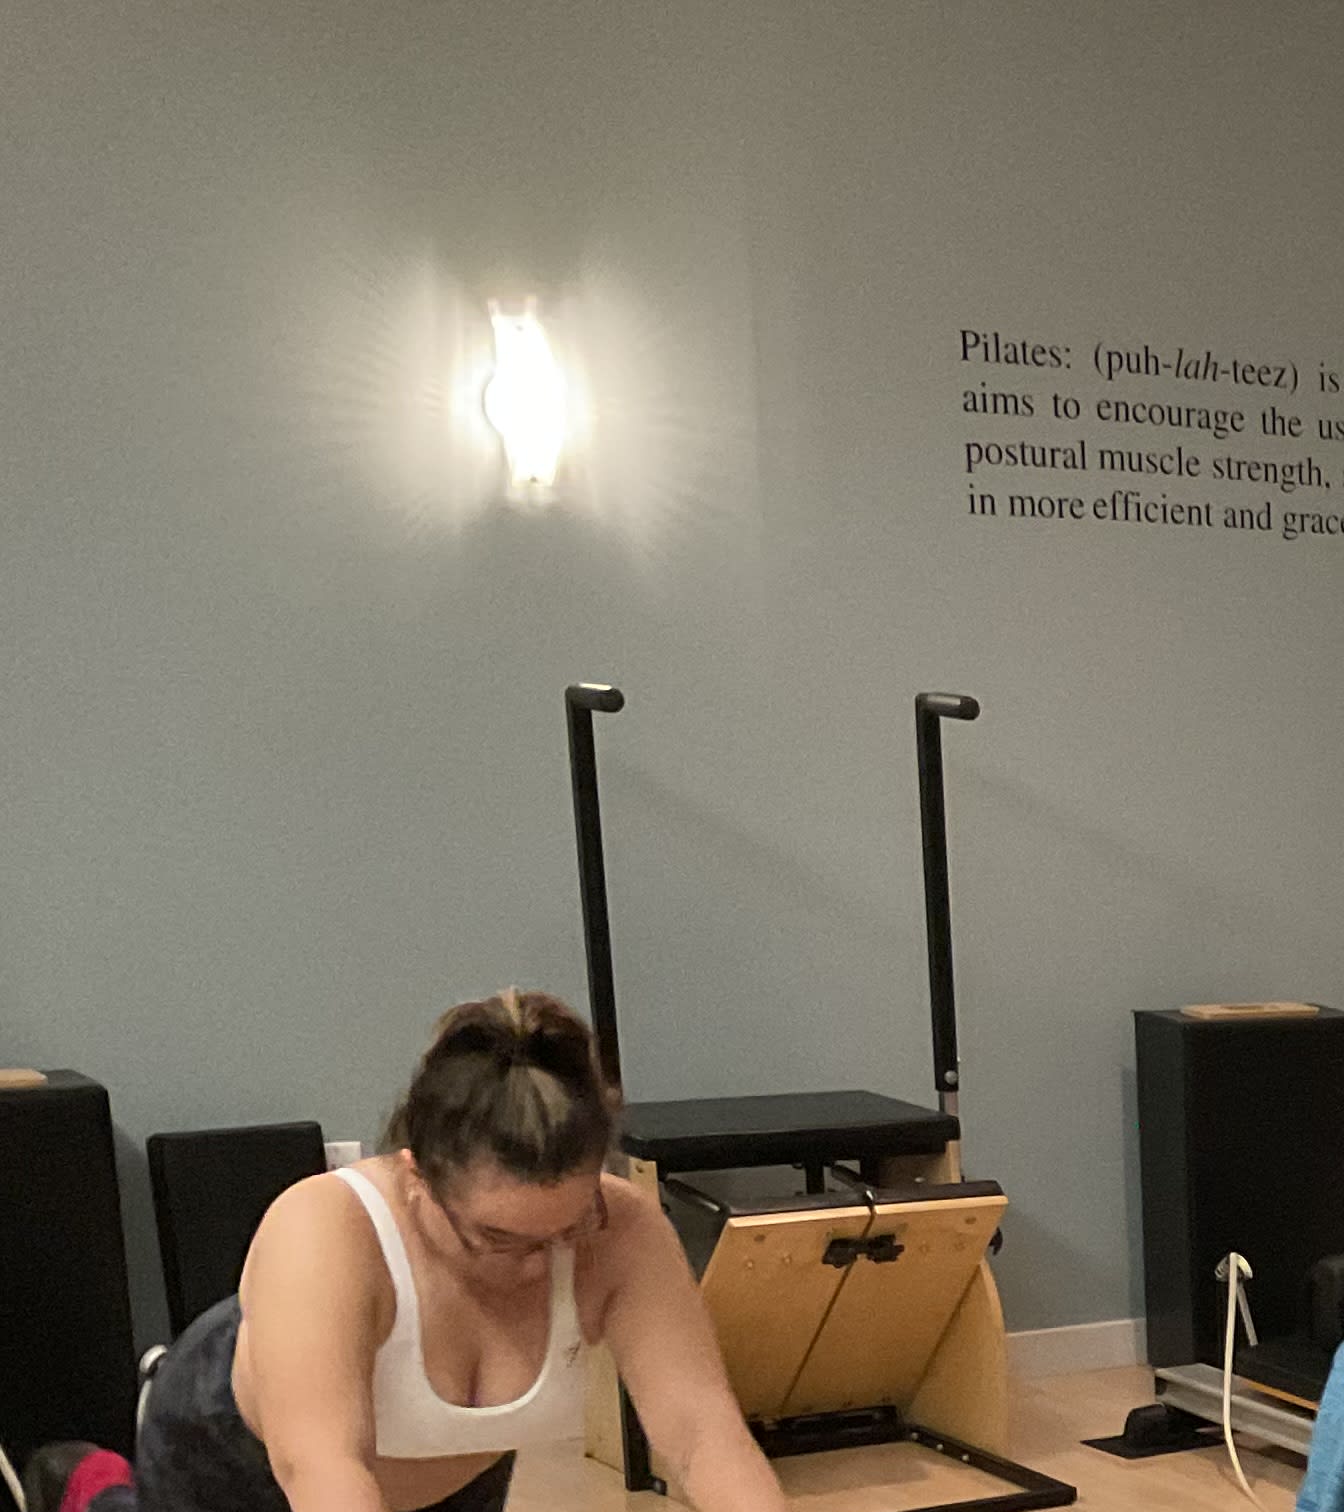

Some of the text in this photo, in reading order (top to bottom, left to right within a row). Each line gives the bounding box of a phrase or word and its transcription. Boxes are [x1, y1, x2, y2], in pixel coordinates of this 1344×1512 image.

[960, 329, 1072, 369] Pilates:
[1094, 341, 1299, 395] (puh-lah-teez)
[1319, 361, 1341, 394] is
[962, 382, 1035, 417] aims
[1053, 391, 1081, 420] to
[1096, 399, 1245, 439] encourage
[1261, 407, 1302, 438] the
[965, 440, 1087, 474] postural
[1099, 447, 1202, 477] muscle
[1212, 457, 1331, 494] strength,
[967, 483, 997, 516] in
[1008, 493, 1086, 520] more
[1092, 489, 1214, 527] efficient
[1223, 502, 1273, 532] and
